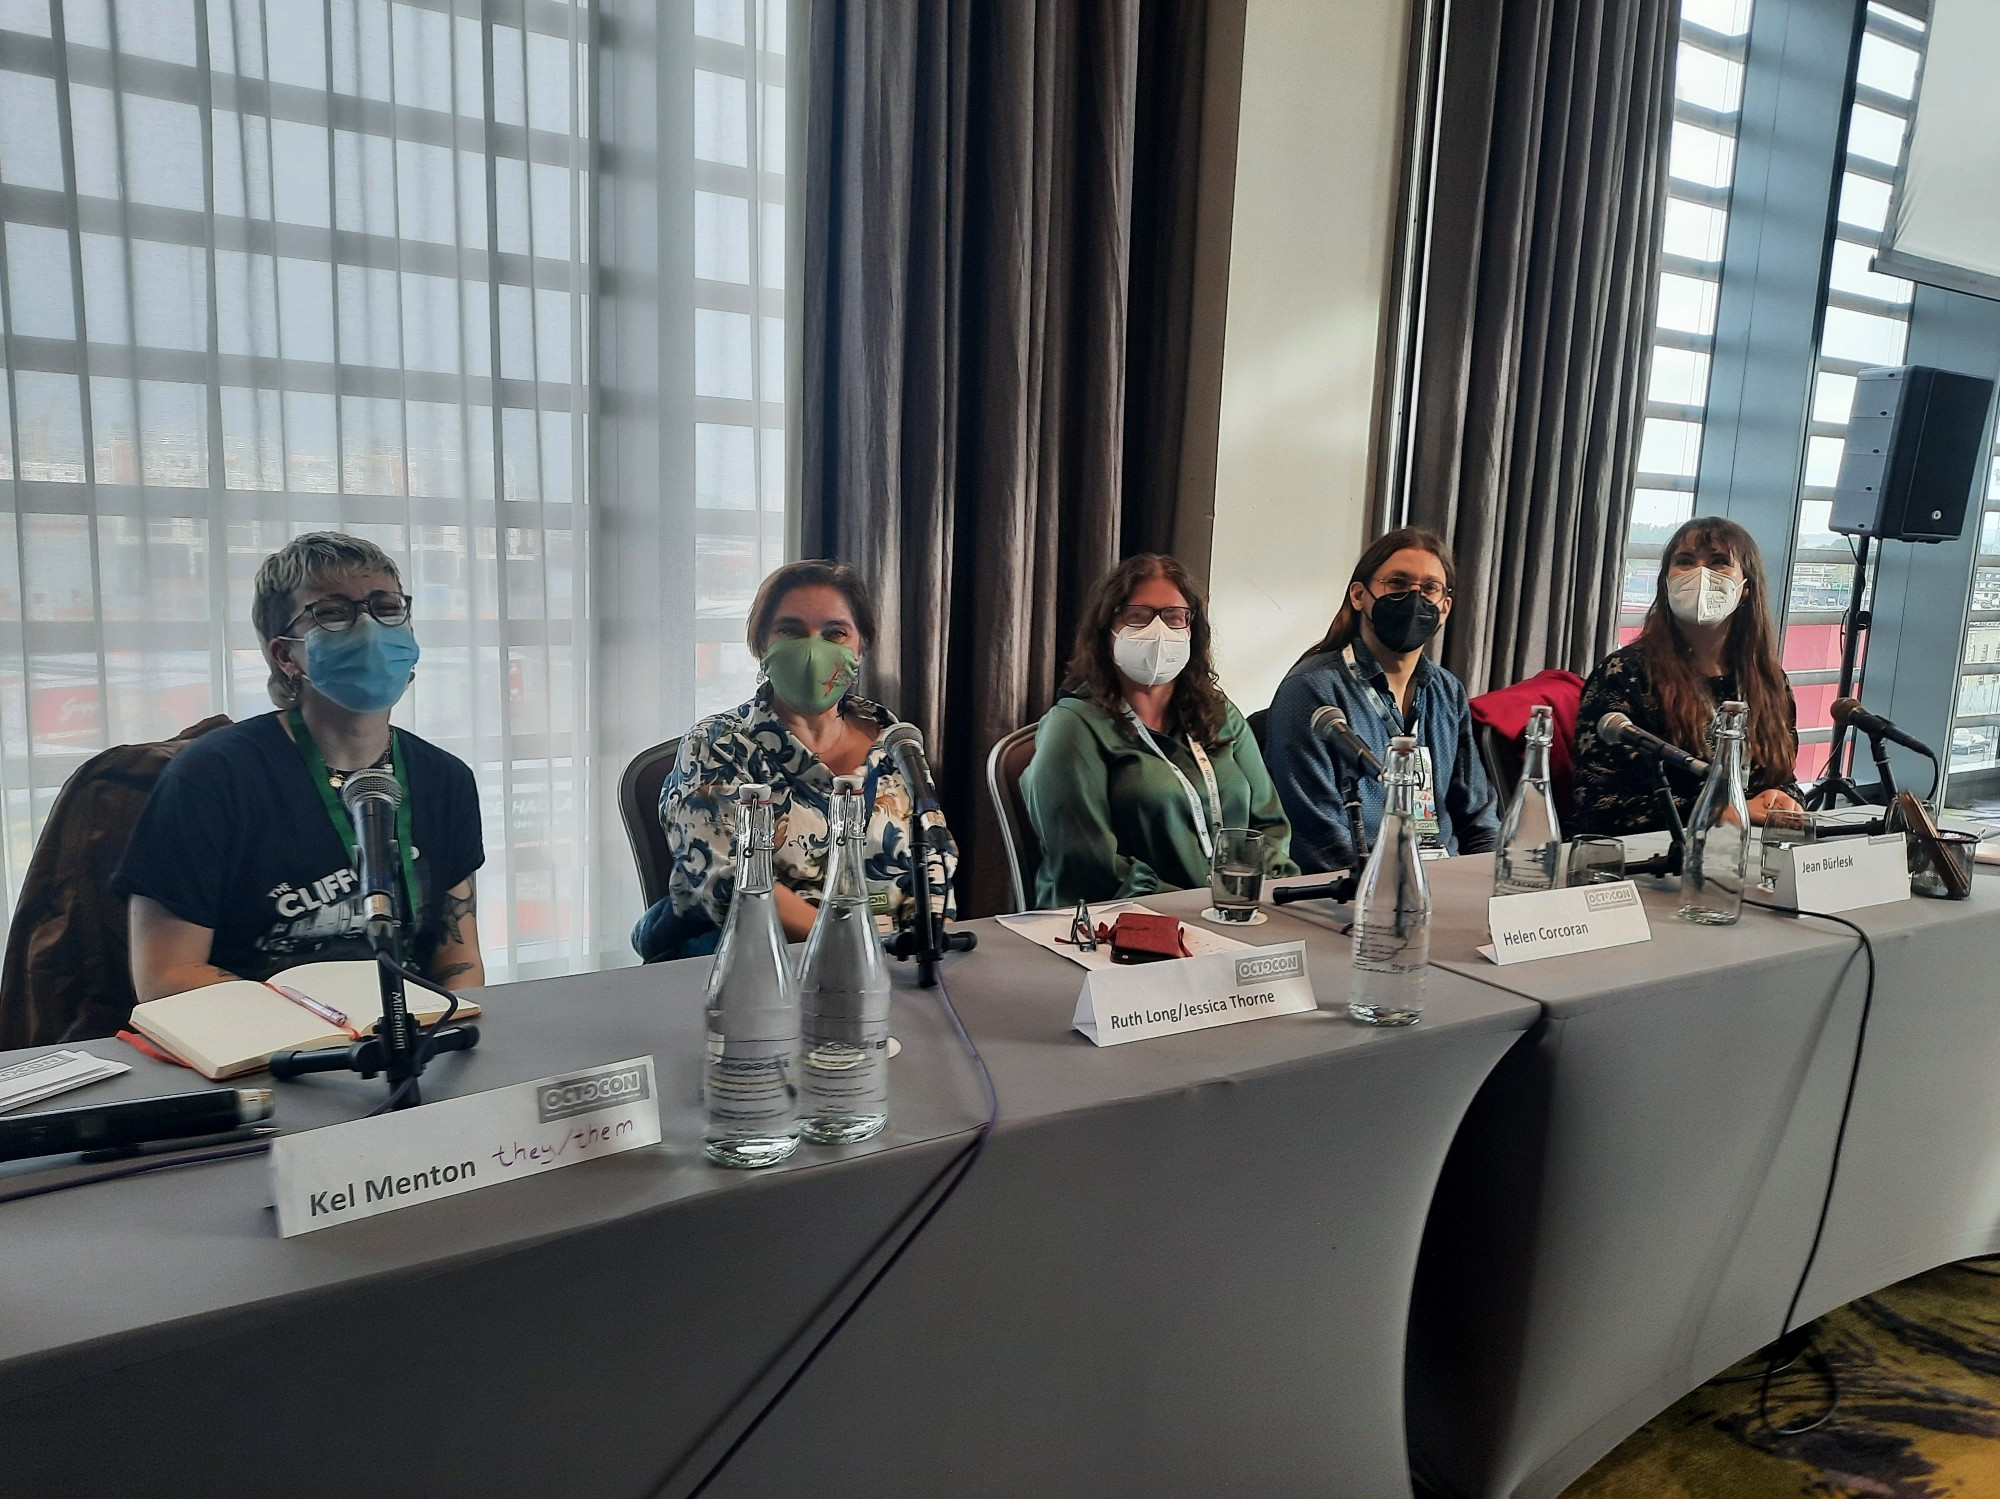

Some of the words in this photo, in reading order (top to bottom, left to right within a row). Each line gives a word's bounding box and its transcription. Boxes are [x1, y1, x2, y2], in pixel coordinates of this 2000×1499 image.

[1802, 861, 1821, 873] Jean
[1822, 855, 1854, 871] Bürlesk
[267, 882, 293, 899] THE
[276, 868, 359, 918] CLIFF
[1503, 930, 1537, 946] Helen
[1538, 923, 1589, 940] Corcoran
[1238, 954, 1298, 979] OCTOCON
[1111, 1010, 1143, 1030] Ruth
[1146, 999, 1228, 1023] Long/Jessica
[1229, 991, 1275, 1010] Thorne
[544, 1069, 642, 1111] OCTOCON
[491, 1118, 634, 1168] they/them
[310, 1184, 356, 1217] Kel
[364, 1158, 477, 1204] Menton
